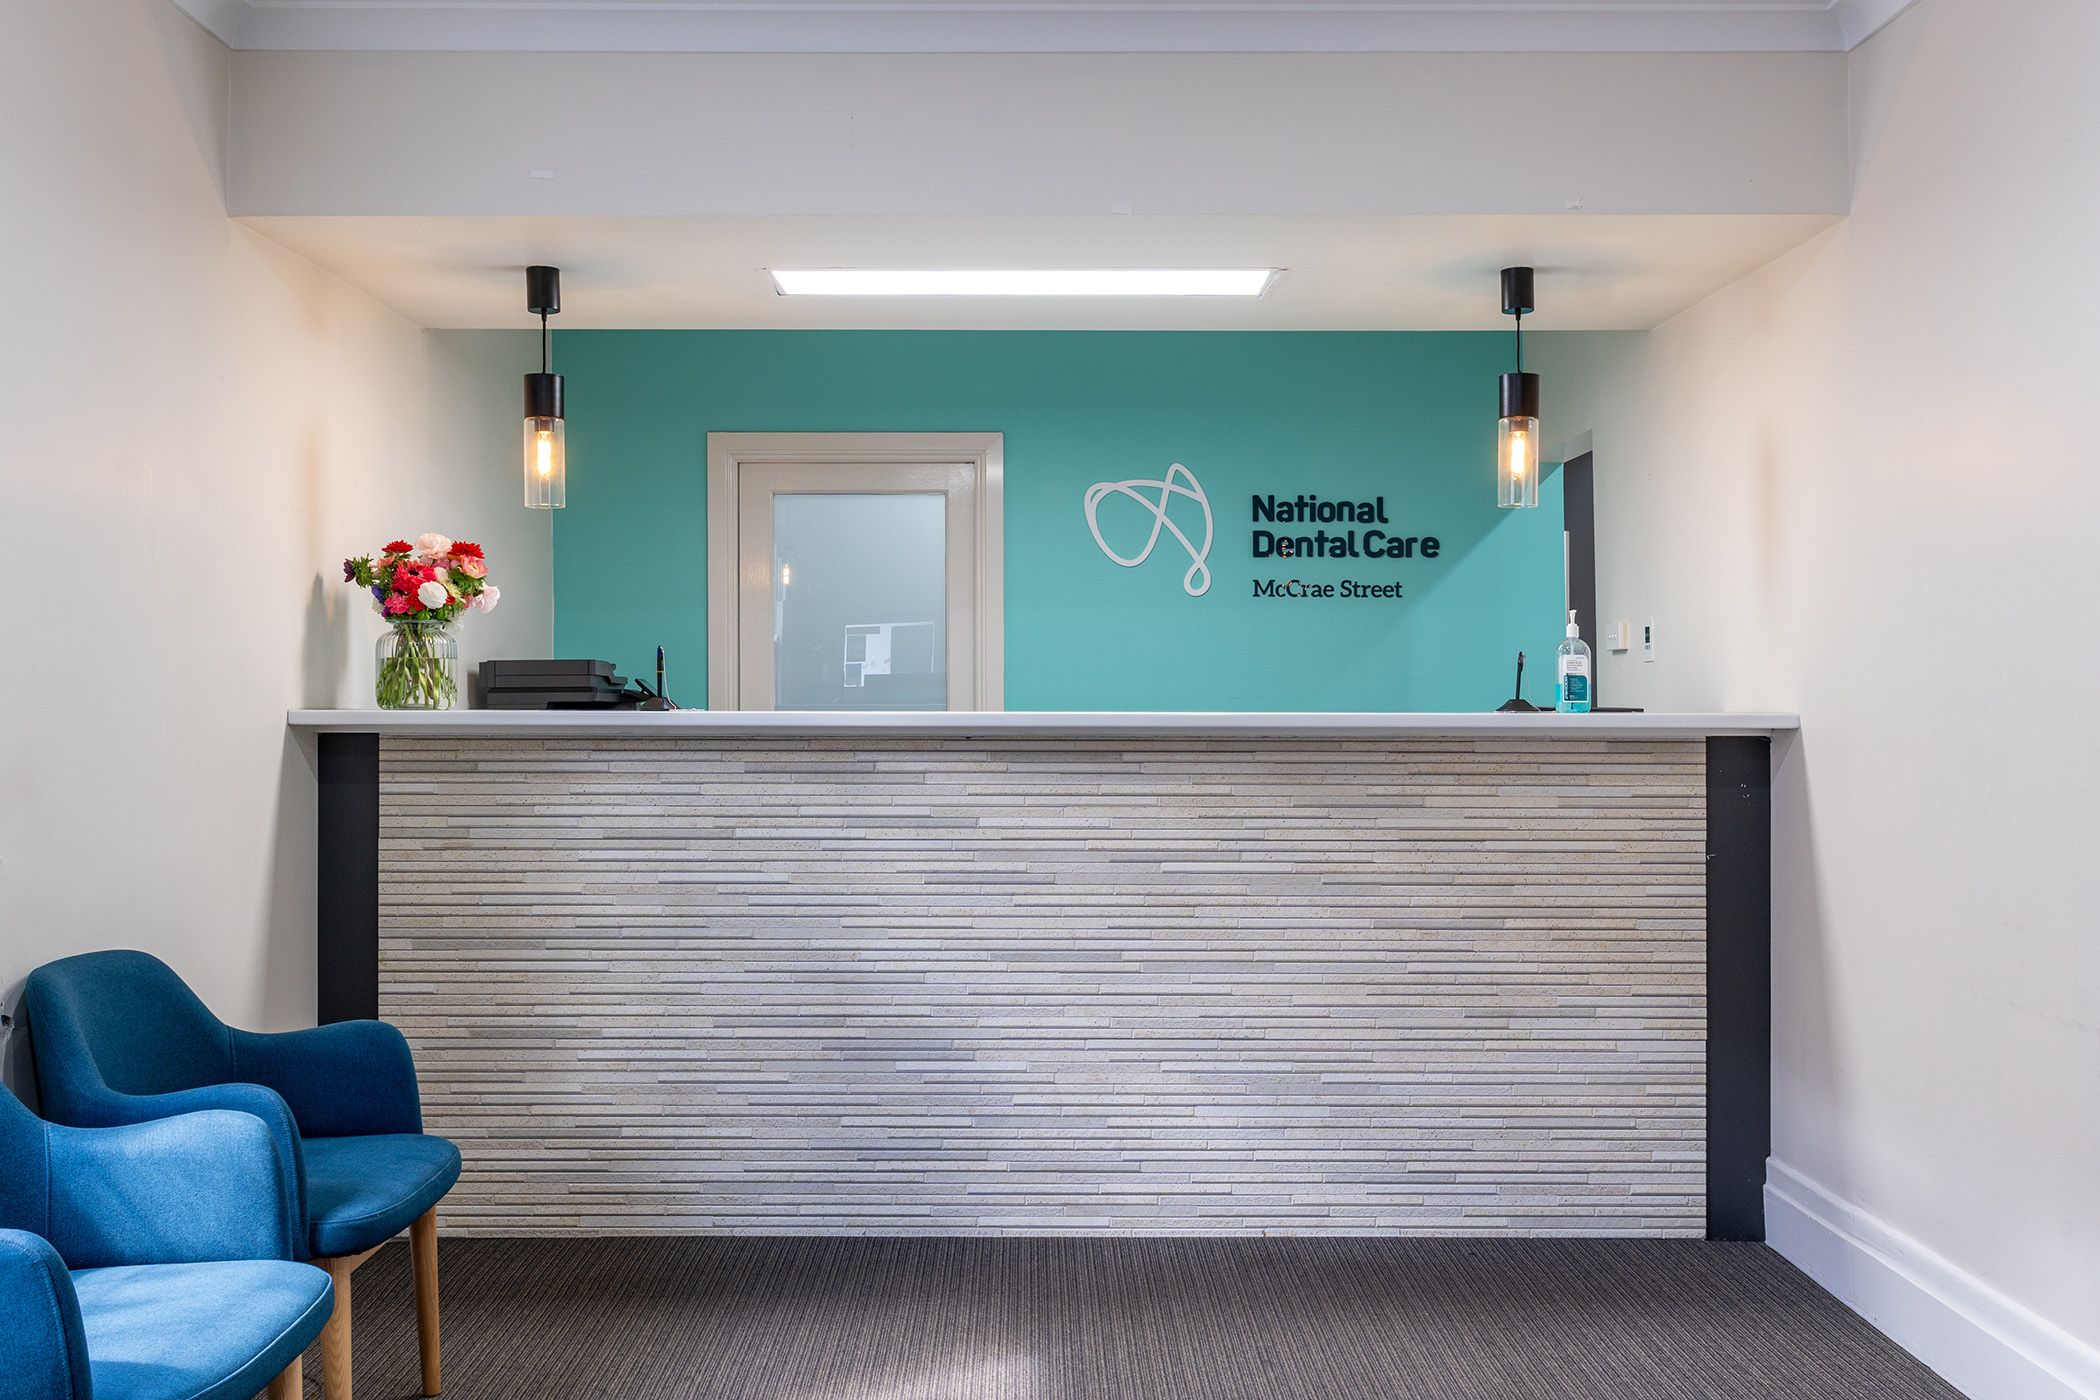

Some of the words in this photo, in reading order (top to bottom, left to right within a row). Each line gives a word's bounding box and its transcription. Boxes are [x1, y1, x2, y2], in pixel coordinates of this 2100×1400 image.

[1252, 494, 1389, 524] National
[1252, 530, 1360, 558] Dental
[1362, 530, 1440, 558] Care
[1252, 579, 1335, 598] McCrae
[1339, 579, 1403, 598] Street
